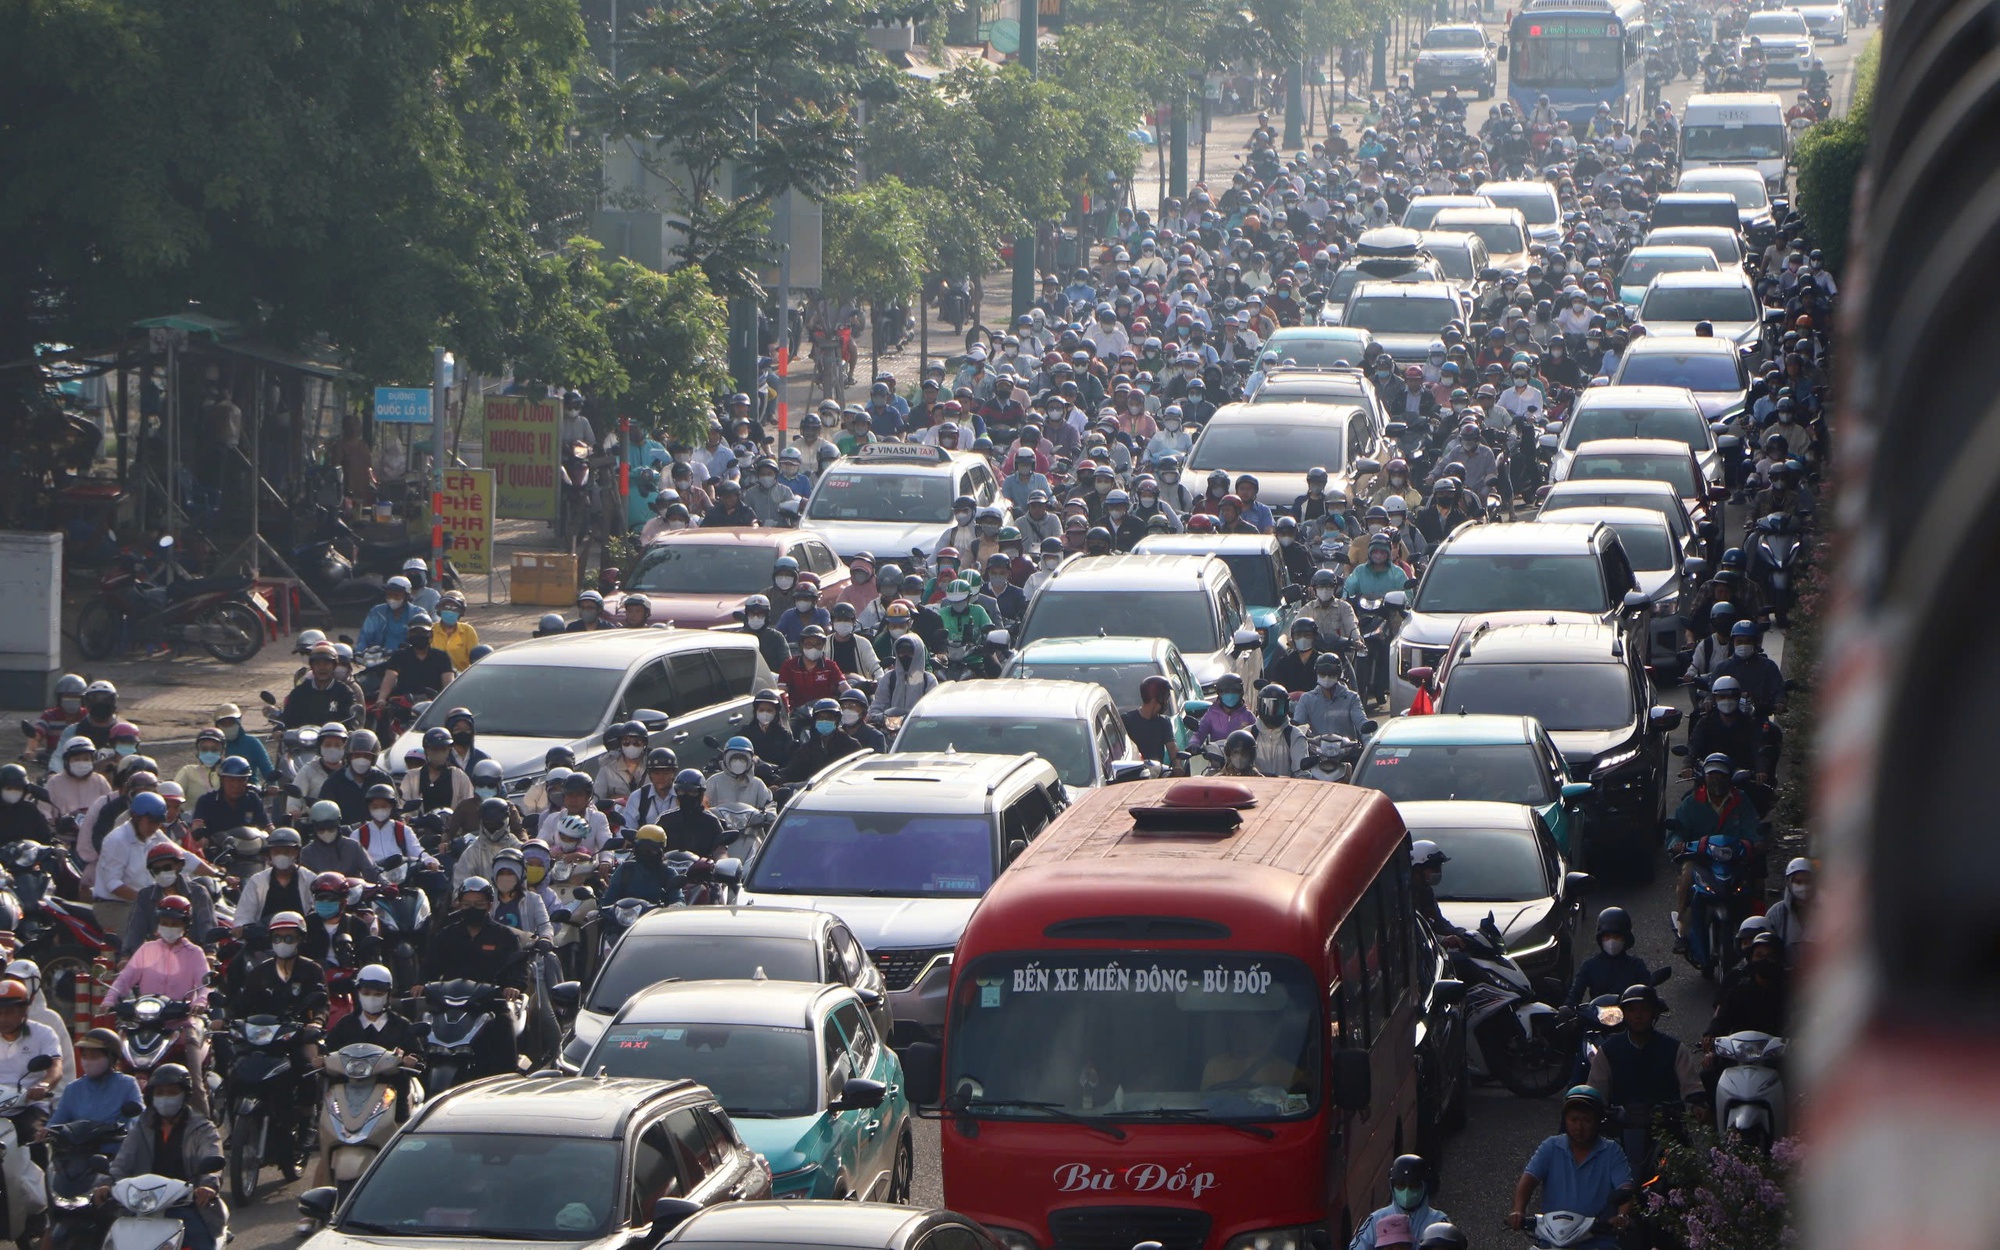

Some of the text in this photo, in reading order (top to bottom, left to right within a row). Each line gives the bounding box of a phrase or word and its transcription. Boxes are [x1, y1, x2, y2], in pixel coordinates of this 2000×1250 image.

[377, 401, 402, 416] QUỐC
[418, 405, 428, 416] 13
[877, 446, 936, 456] VINASUN TAXI
[446, 471, 475, 491] CÀ
[449, 533, 485, 551] ÁY
[1375, 758, 1400, 766] TAXI
[1012, 961, 1050, 992] BẾN
[1053, 969, 1079, 992] XE
[1083, 961, 1131, 992] MIỀN
[1134, 964, 1189, 993] ĐÔNG
[1203, 964, 1229, 993] BÙ
[1233, 963, 1272, 994] ĐỐP
[619, 1041, 649, 1049] TAXI
[1053, 1162, 1222, 1199] Bù Đốp
